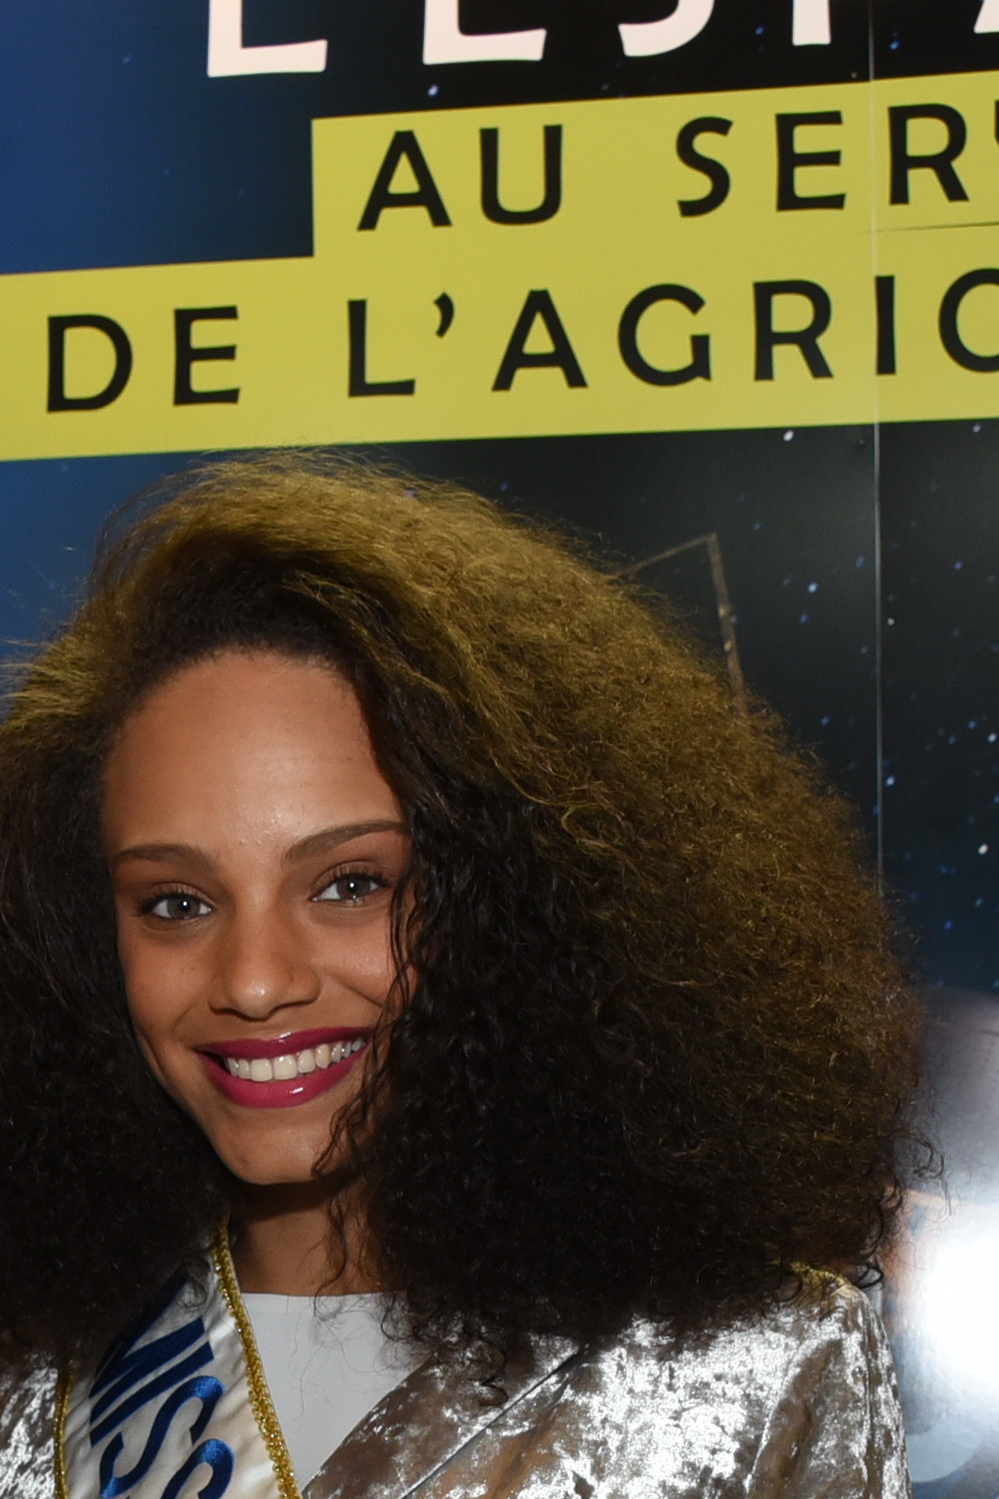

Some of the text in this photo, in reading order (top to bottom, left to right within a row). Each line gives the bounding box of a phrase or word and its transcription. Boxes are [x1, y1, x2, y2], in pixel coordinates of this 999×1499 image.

[356, 99, 999, 231] AU SER
[46, 305, 241, 413] DE
